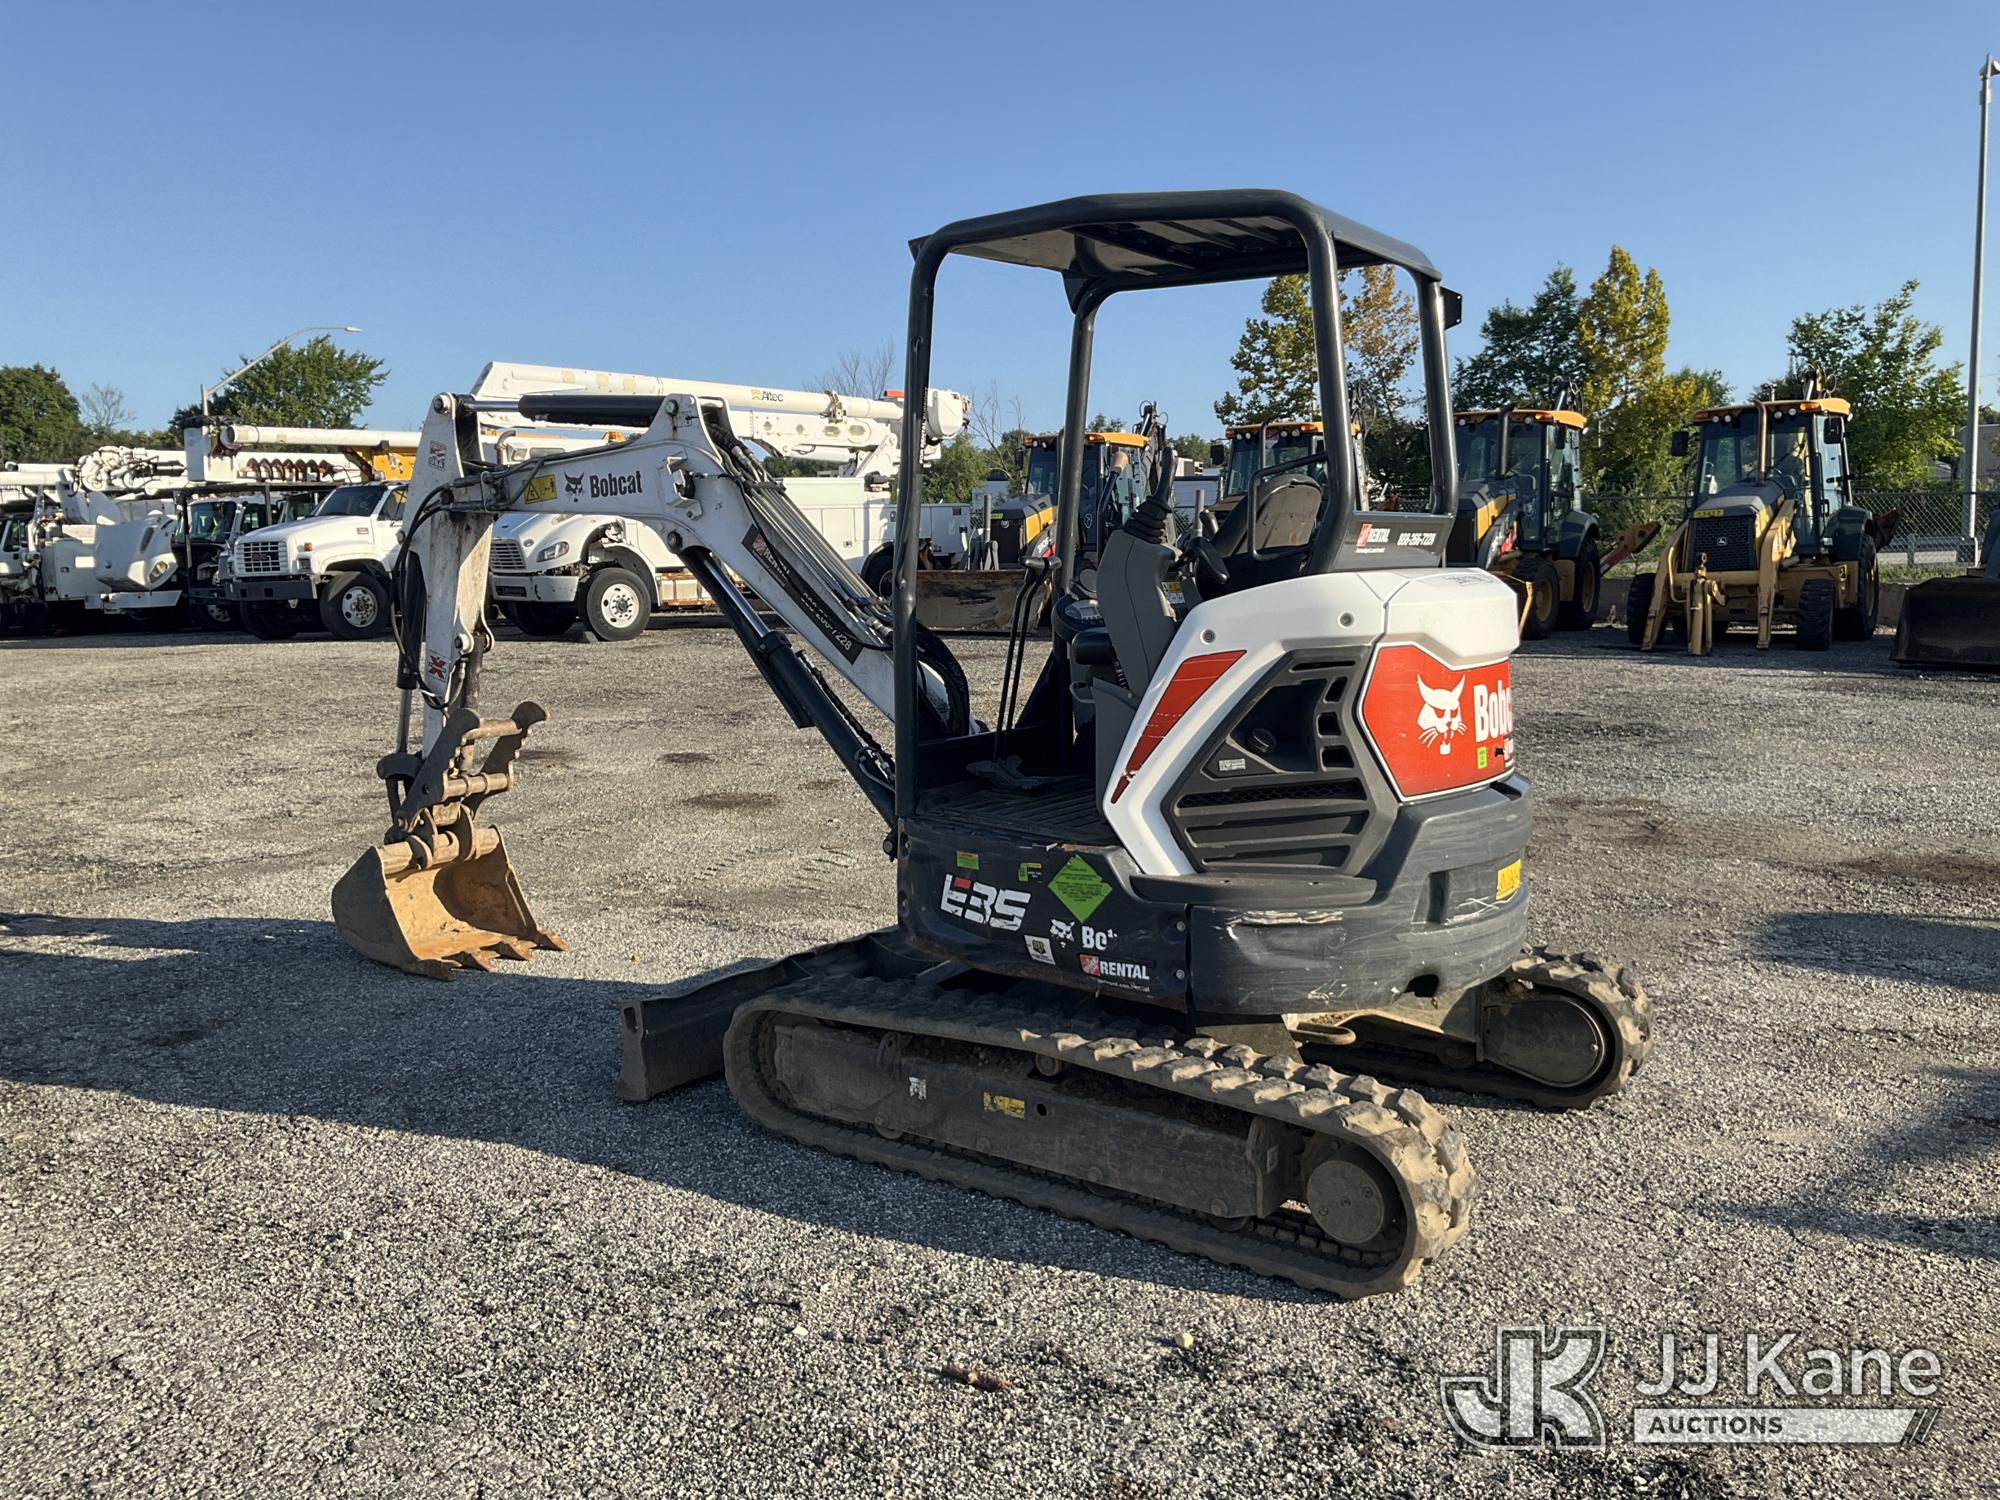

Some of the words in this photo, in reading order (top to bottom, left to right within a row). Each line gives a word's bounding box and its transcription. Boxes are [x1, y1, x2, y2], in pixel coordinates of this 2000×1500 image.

[761, 390, 784, 402] Altec
[590, 470, 643, 498] Bobcat
[1367, 528, 1391, 542] RENTAL
[1099, 960, 1150, 980] RENTAL
